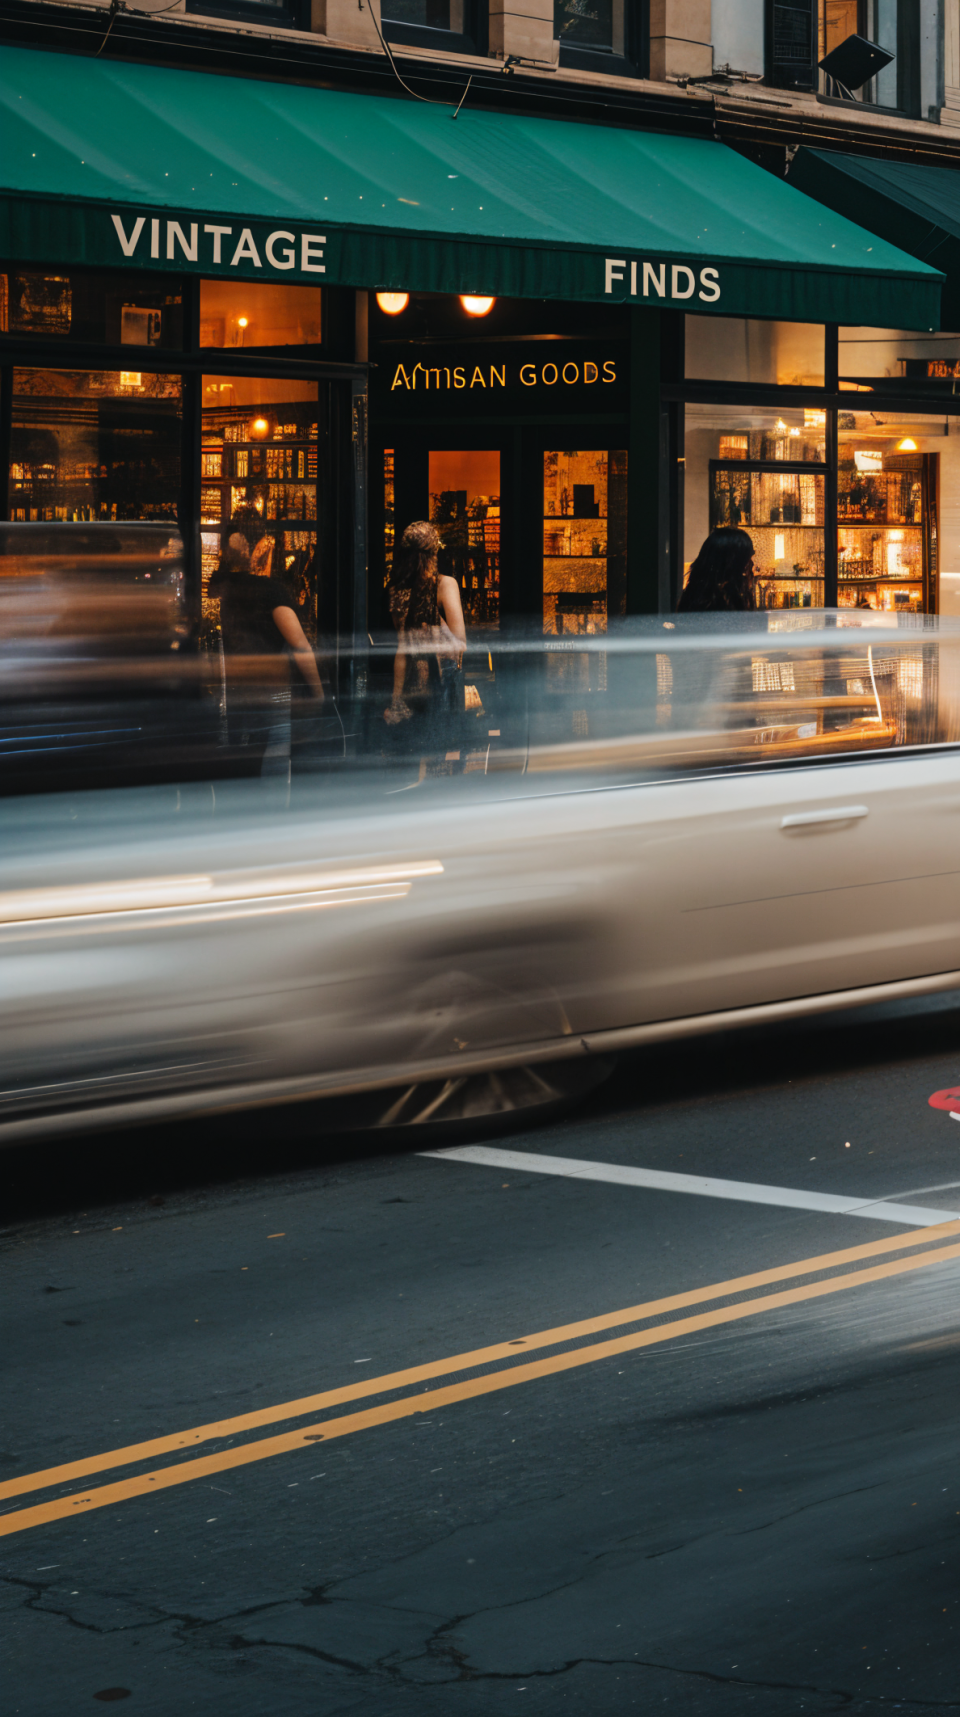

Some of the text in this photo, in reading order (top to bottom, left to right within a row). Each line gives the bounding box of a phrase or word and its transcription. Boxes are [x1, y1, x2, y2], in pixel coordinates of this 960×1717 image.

[110, 214, 721, 302] VINTAGE FINDS
[519, 360, 617, 386] GOODS
